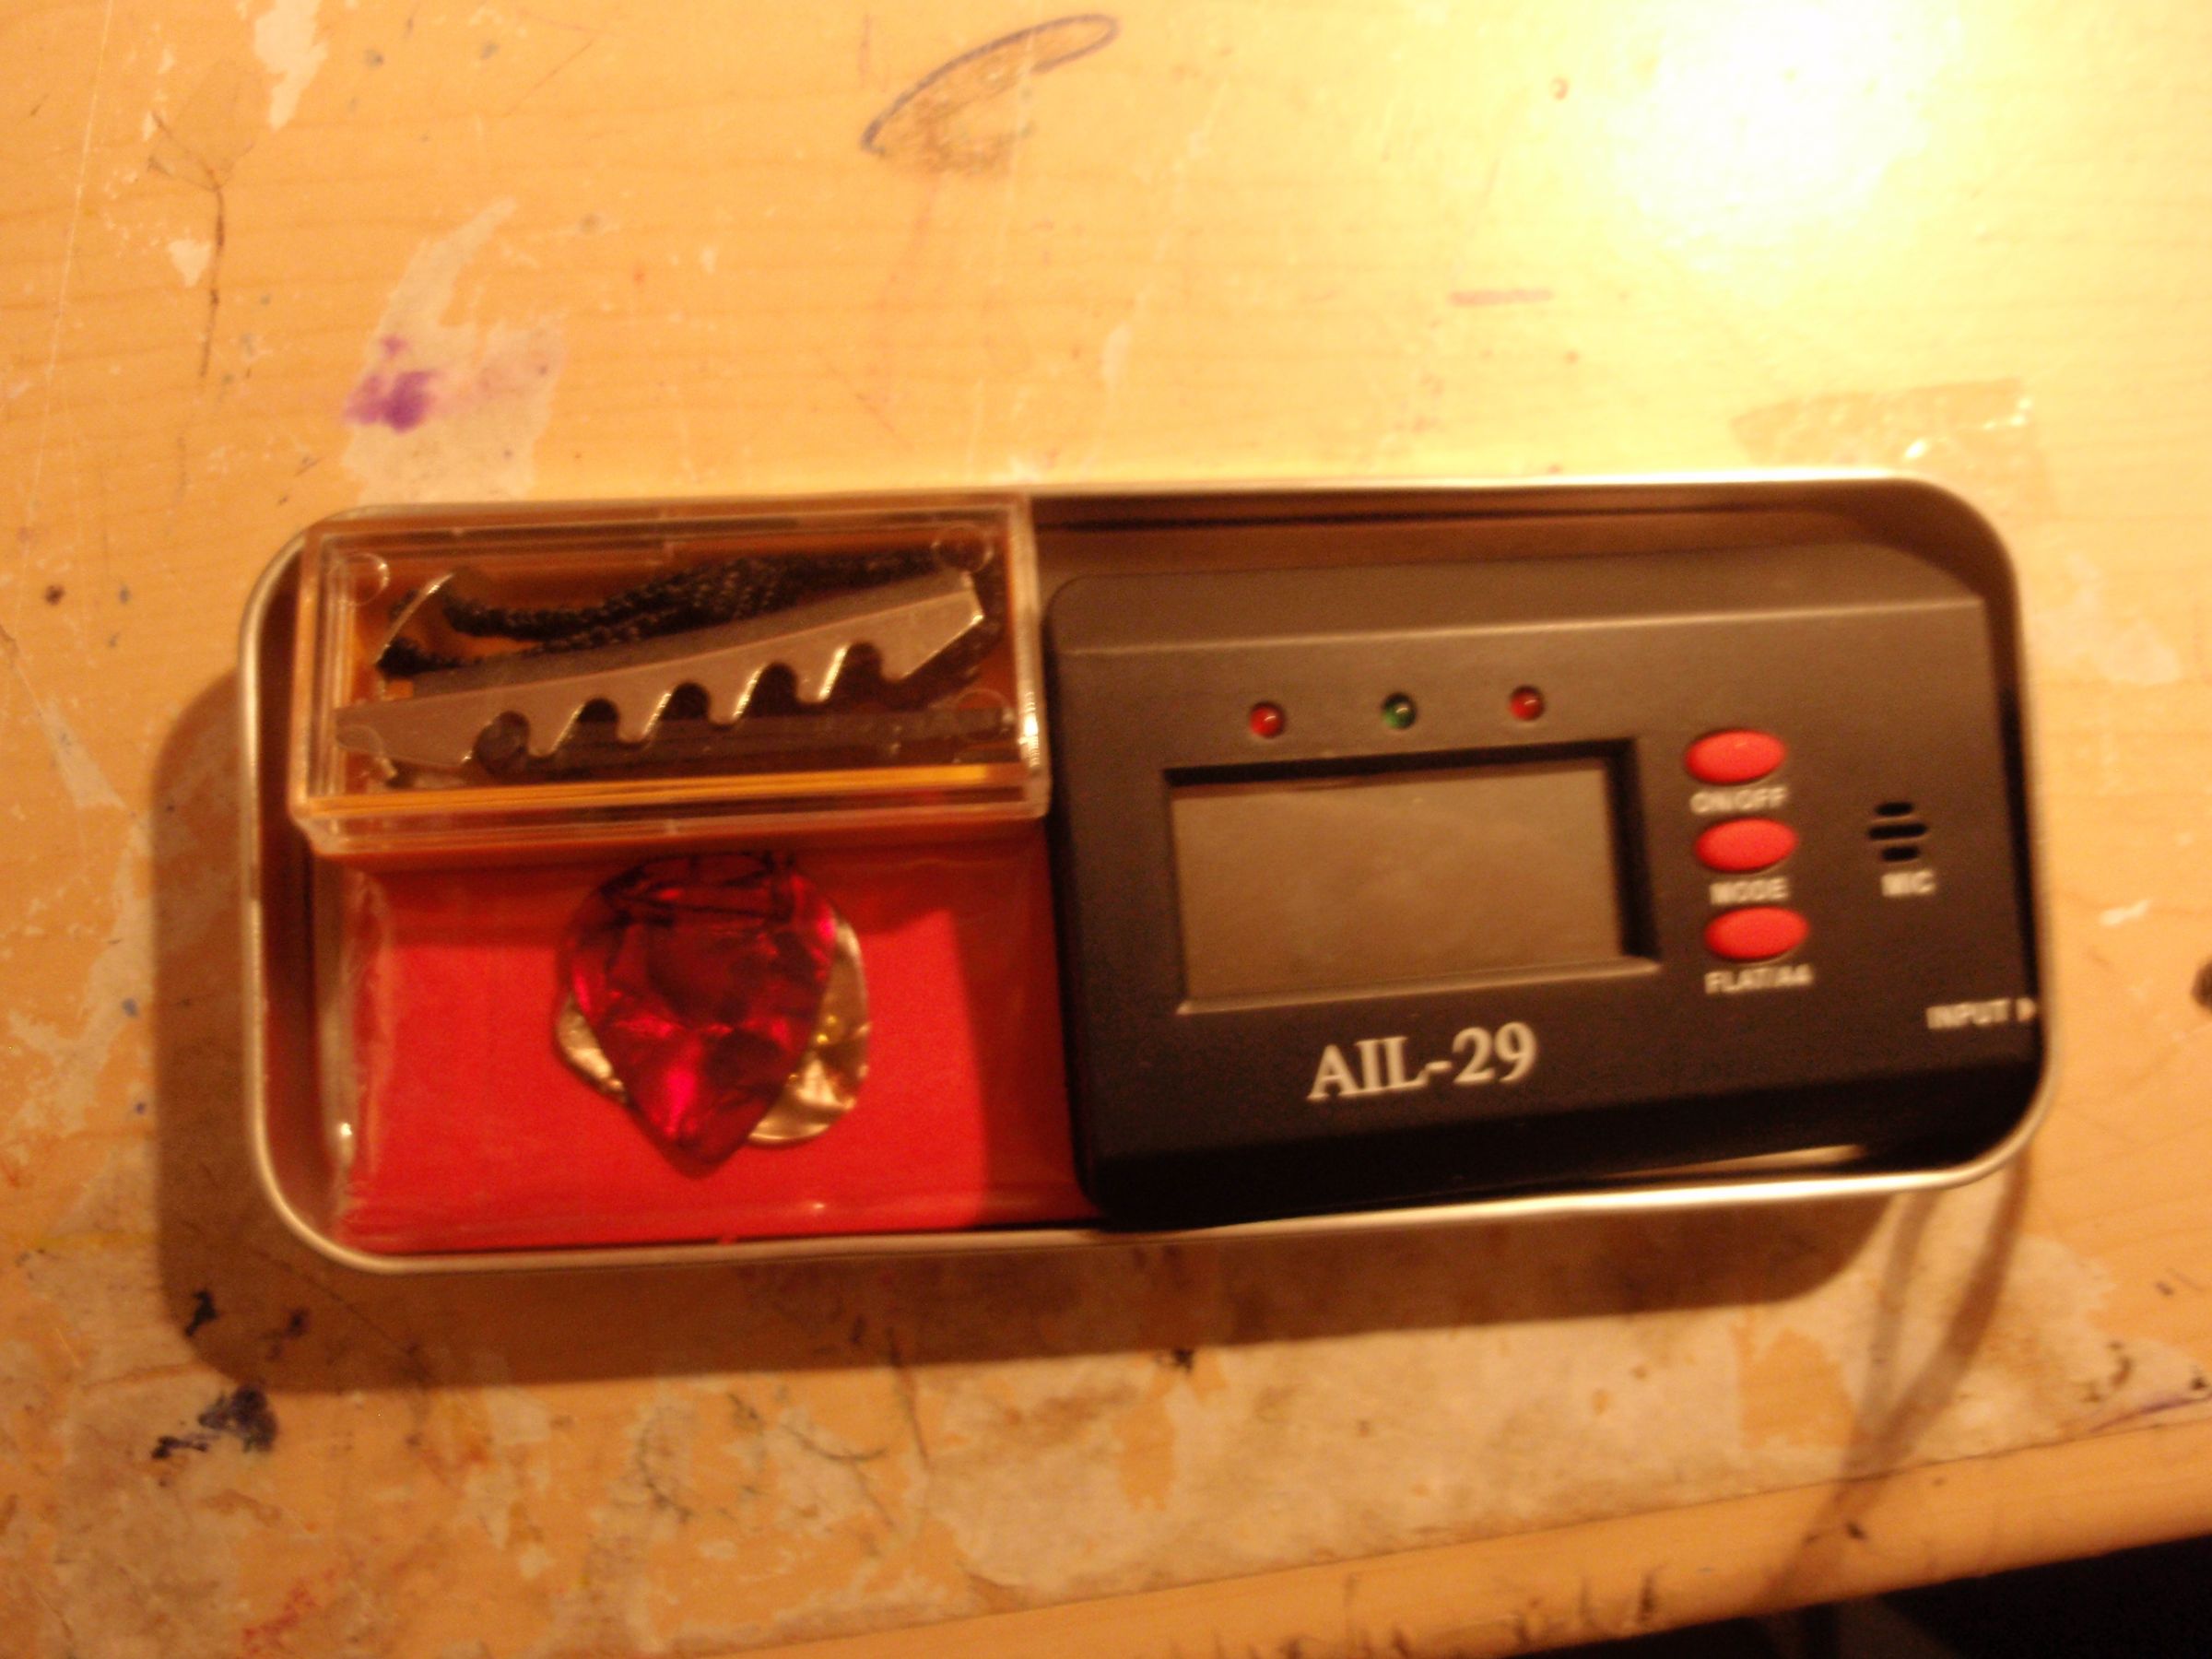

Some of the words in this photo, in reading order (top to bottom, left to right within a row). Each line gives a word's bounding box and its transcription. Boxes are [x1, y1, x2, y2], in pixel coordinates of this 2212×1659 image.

[1709, 877, 1790, 906] MODE
[1880, 871, 1936, 898] MIC
[1925, 998, 2010, 1030] INPUT
[1307, 1021, 1539, 1100] AIL-29
